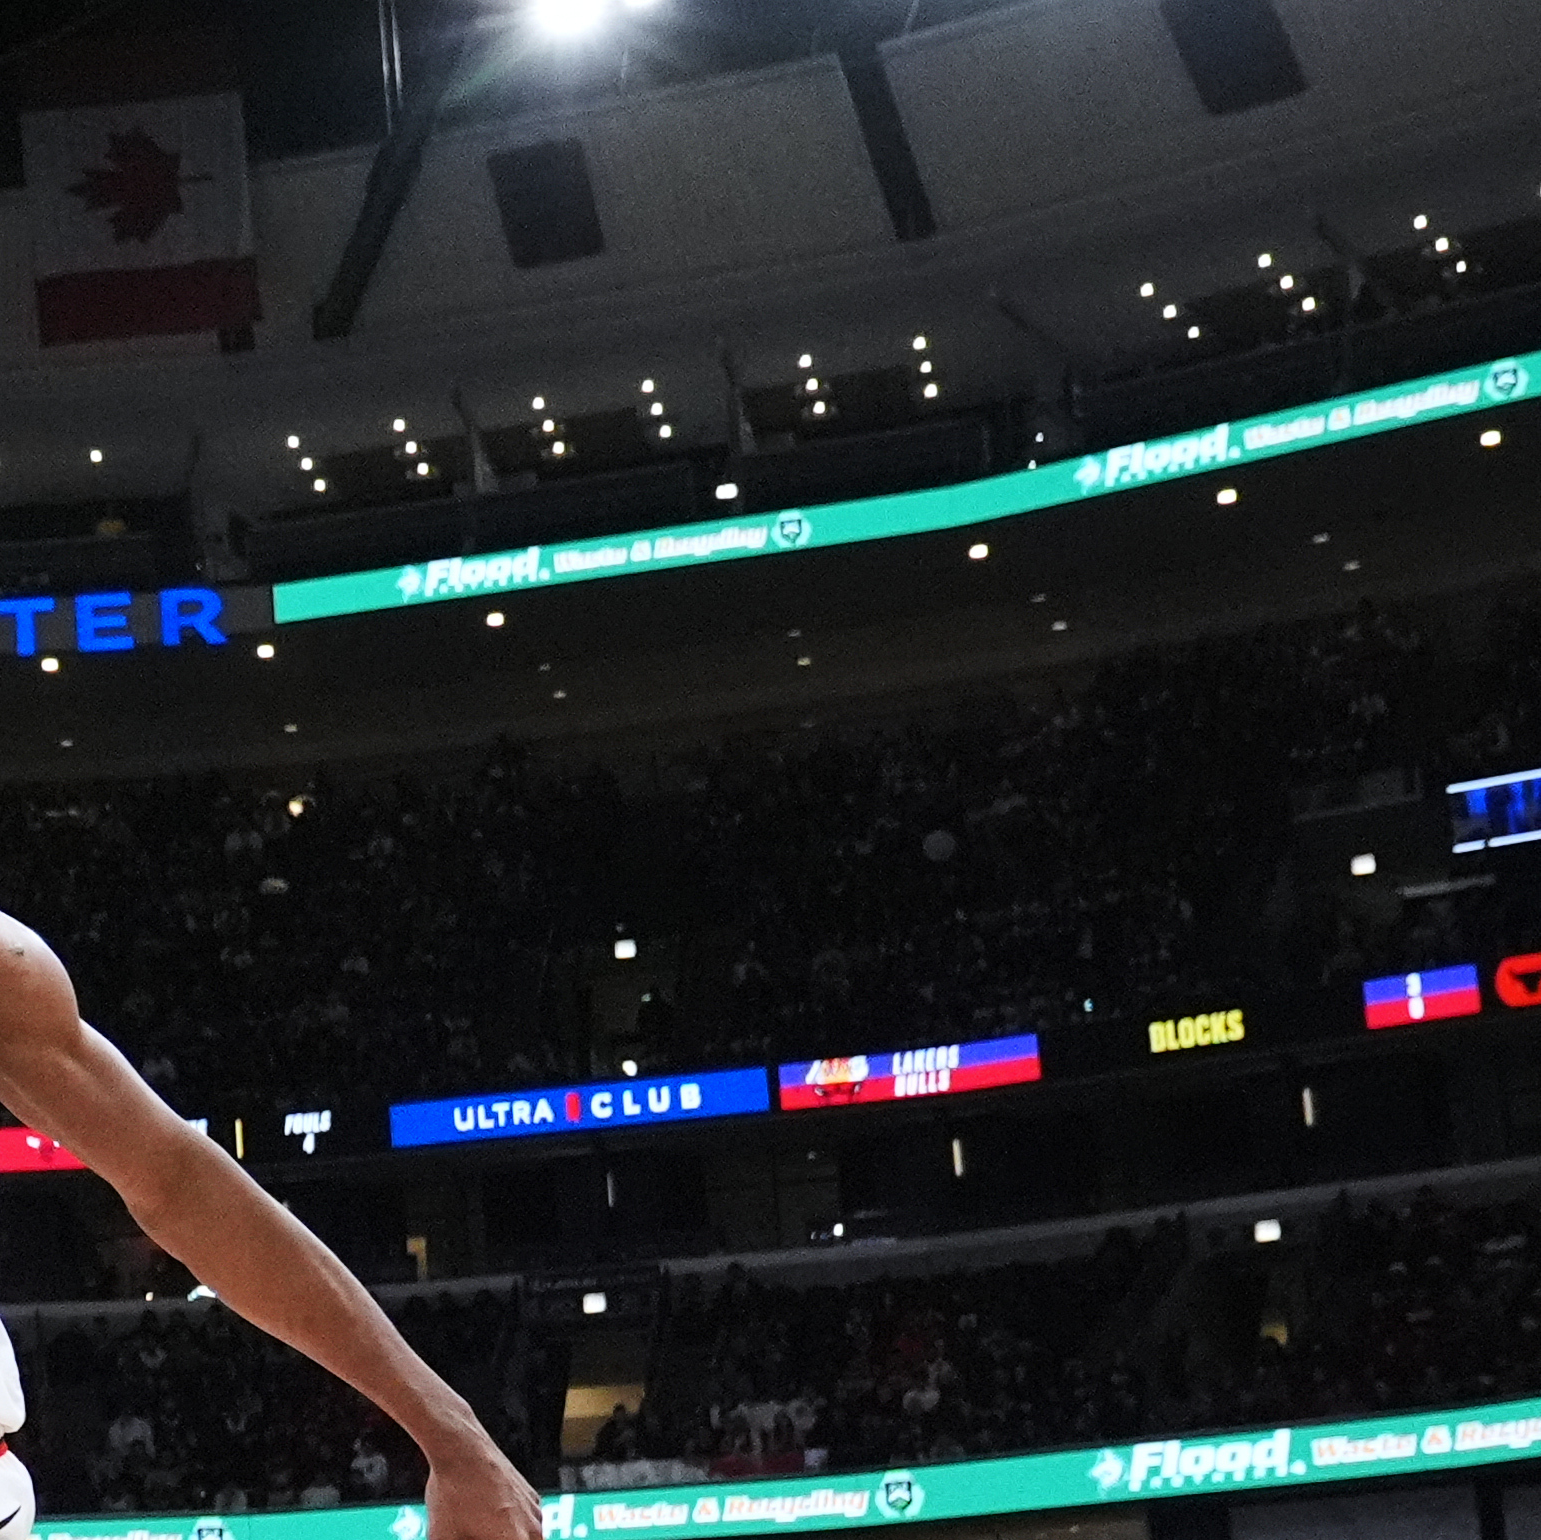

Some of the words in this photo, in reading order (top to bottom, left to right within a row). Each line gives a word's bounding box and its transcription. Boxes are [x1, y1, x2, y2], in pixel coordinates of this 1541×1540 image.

[1148, 1009, 1245, 1054] BLOCKS
[452, 1097, 555, 1132] ULTRA
[590, 1083, 703, 1119] CLUB
[1454, 1418, 1541, 1451] Recyc
